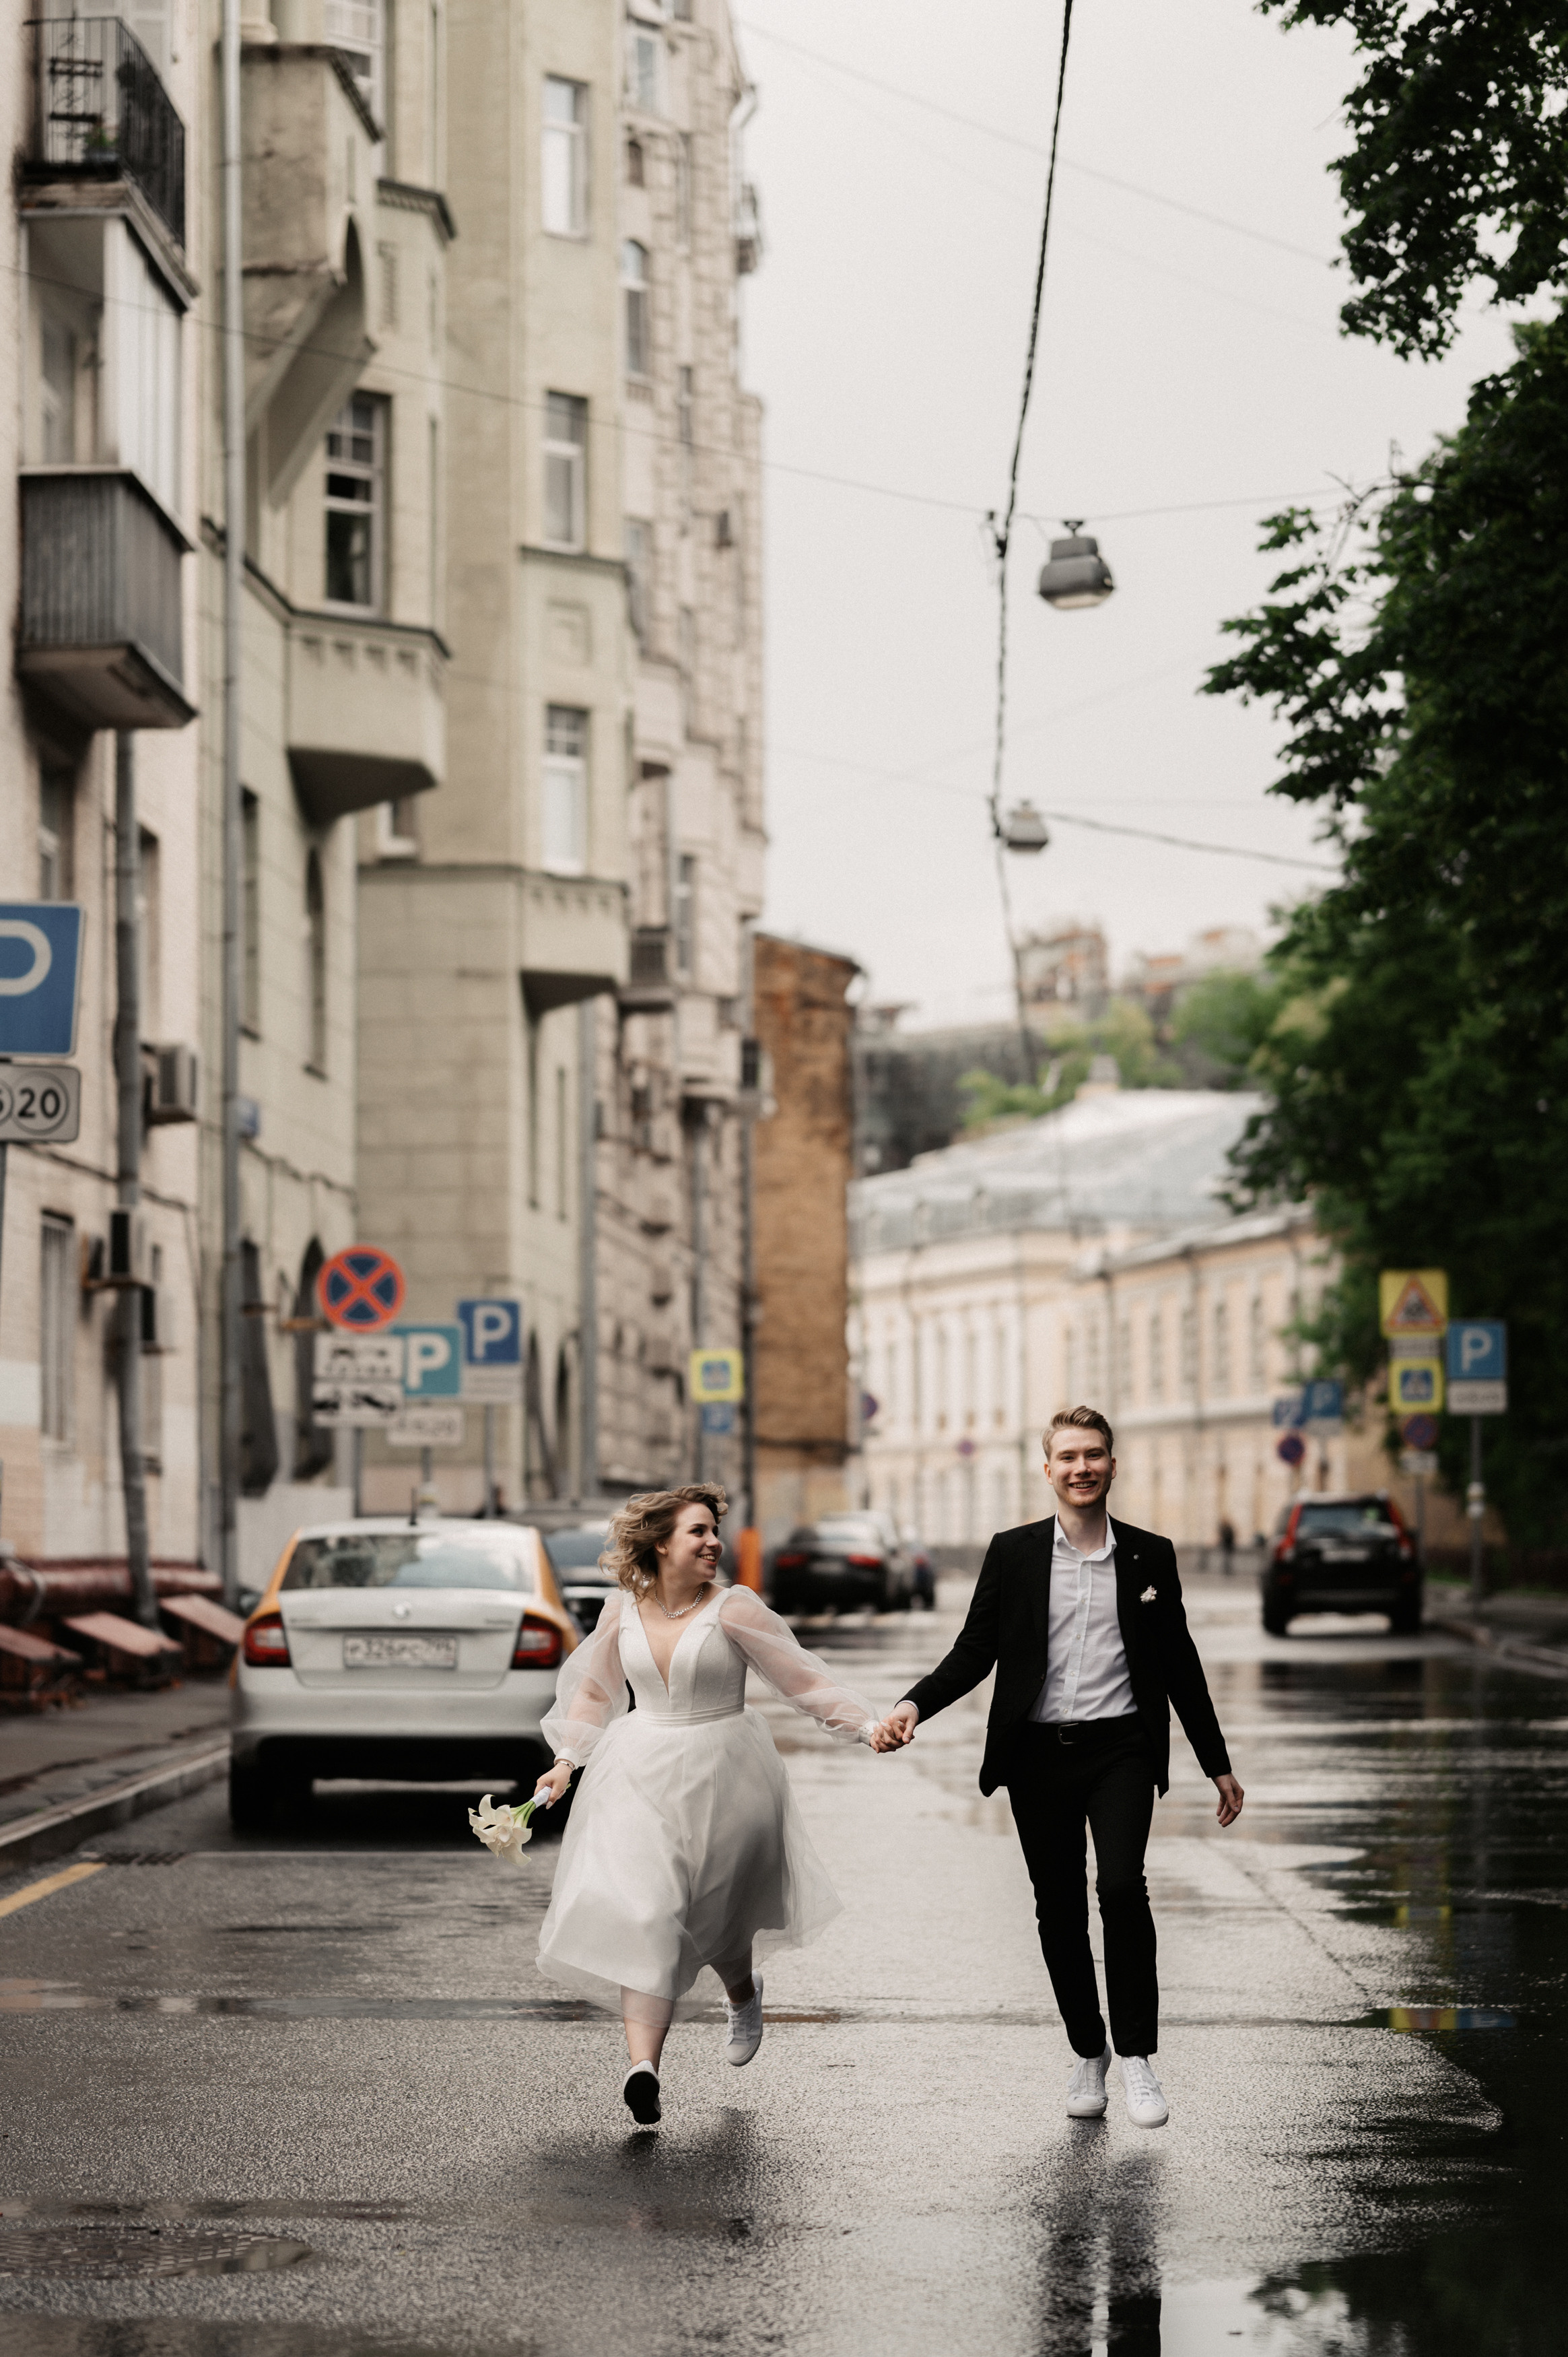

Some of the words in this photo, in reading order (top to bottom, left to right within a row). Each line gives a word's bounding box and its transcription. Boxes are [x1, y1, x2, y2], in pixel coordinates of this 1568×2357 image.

[18, 1087, 60, 1119] 20
[473, 1305, 511, 1359] P
[1461, 1328, 1492, 1372] P
[406, 1332, 450, 1389] P
